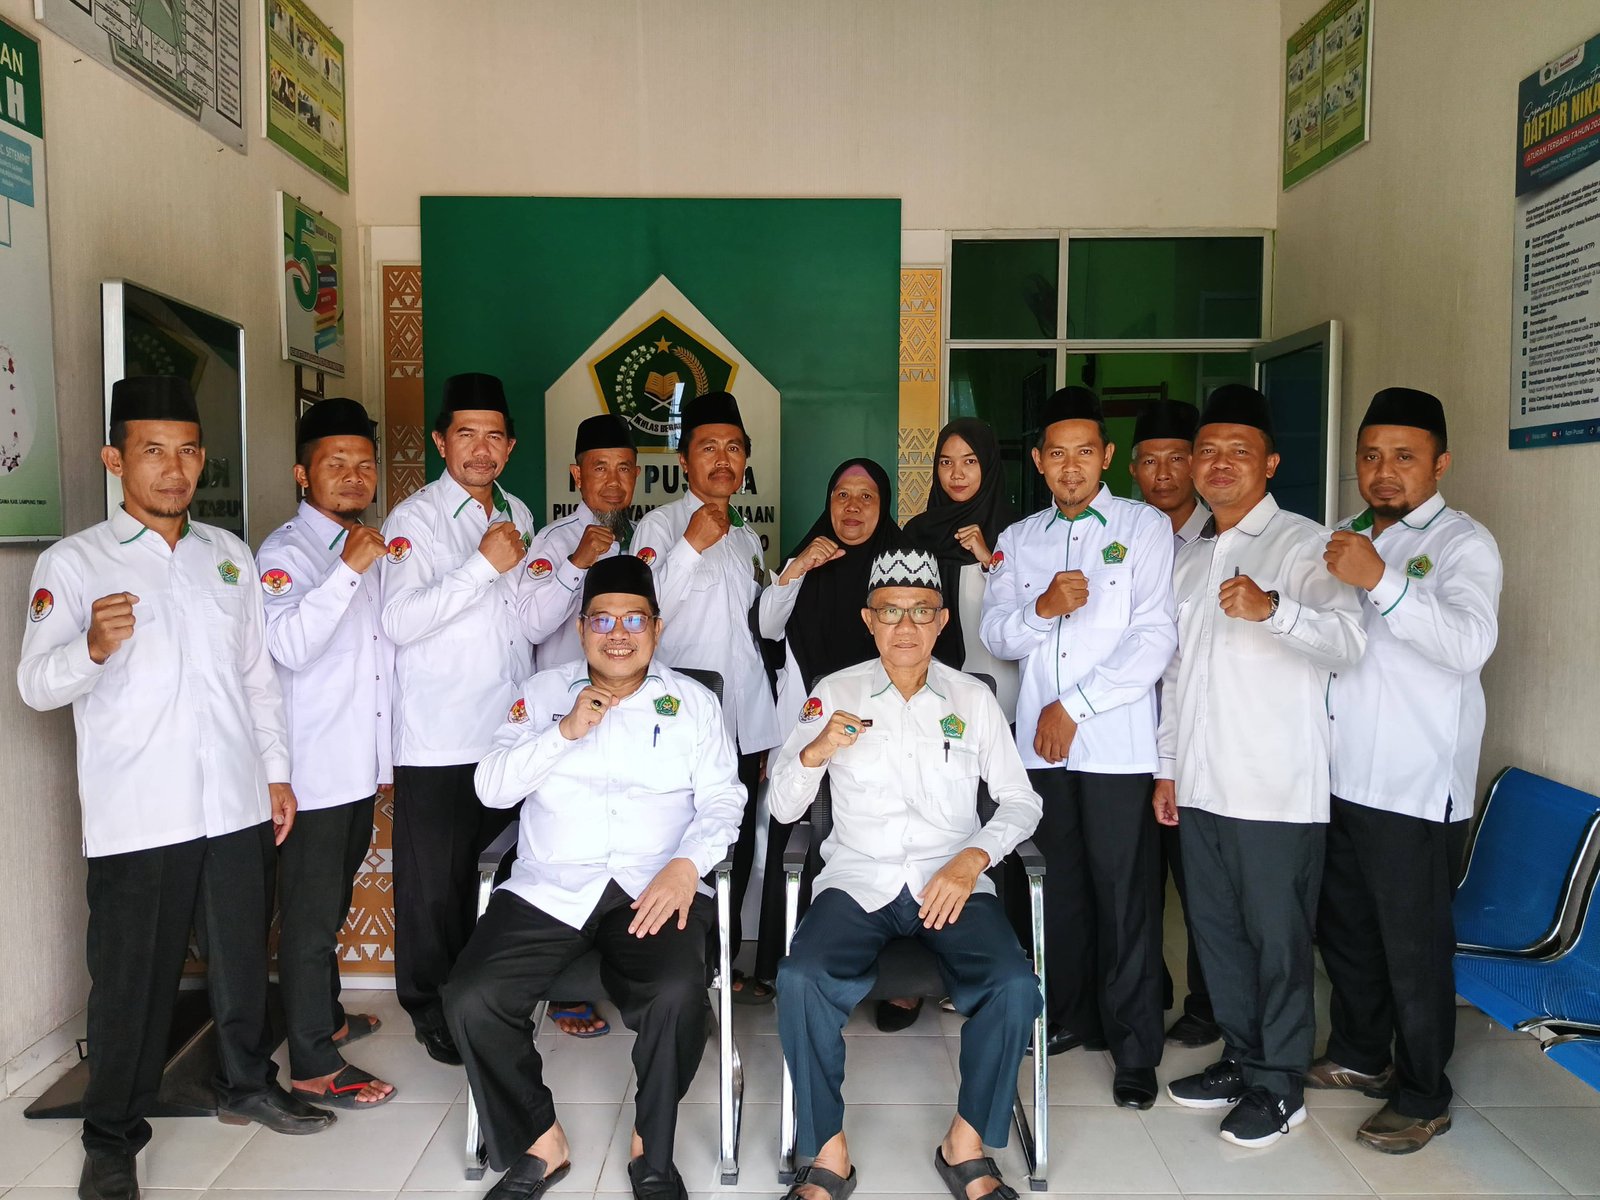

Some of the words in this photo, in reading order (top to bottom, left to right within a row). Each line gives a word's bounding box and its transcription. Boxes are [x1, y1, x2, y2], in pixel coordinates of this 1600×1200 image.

[0, 75, 25, 125] H
[1523, 101, 1568, 148] DAFTAR
[1526, 147, 1547, 162] ATURAN
[1547, 134, 1571, 152] TERBARU
[1570, 124, 1591, 140] TAHUN
[293, 206, 319, 312] 5
[634, 415, 659, 432] IKHLAS
